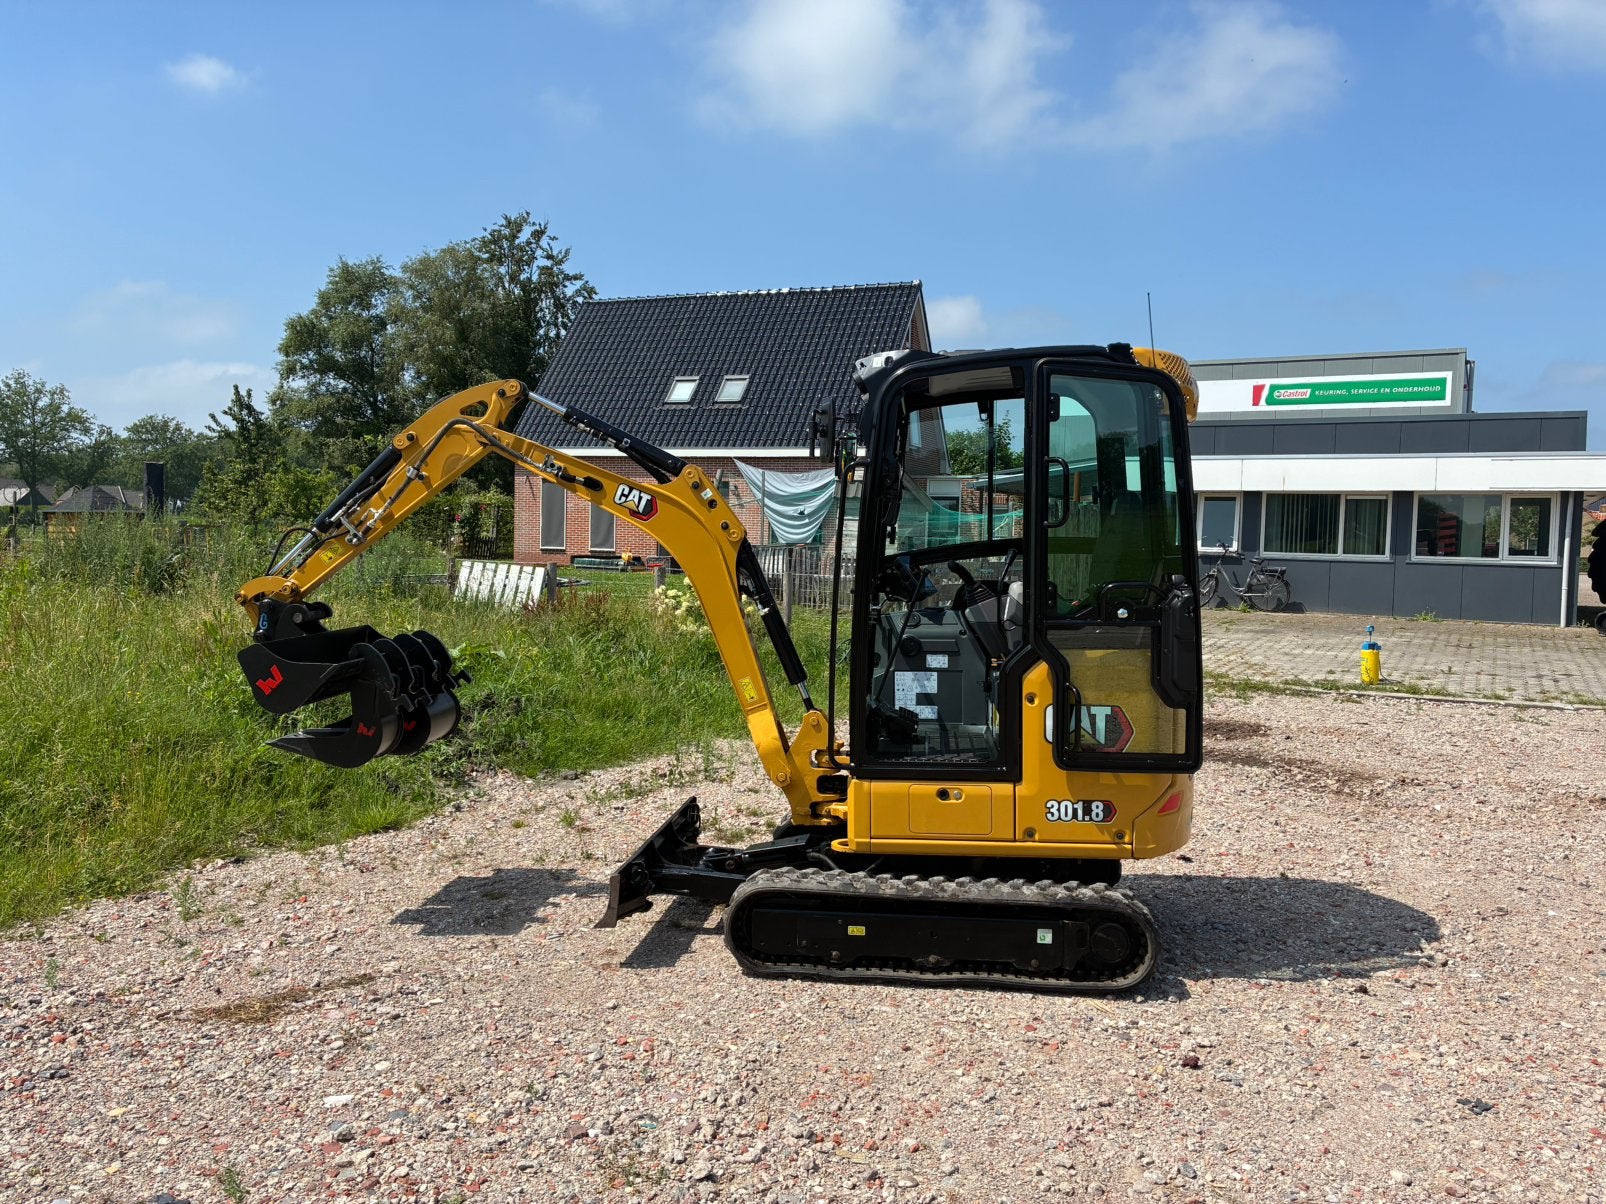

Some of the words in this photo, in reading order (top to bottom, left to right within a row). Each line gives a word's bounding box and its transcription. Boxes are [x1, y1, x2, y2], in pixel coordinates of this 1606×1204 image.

[1282, 390, 1309, 398] Castrol
[1392, 385, 1441, 393] ONDERHOUD
[614, 483, 652, 513] CAT
[1045, 704, 1112, 745] AT
[1046, 800, 1104, 821] 301.8
